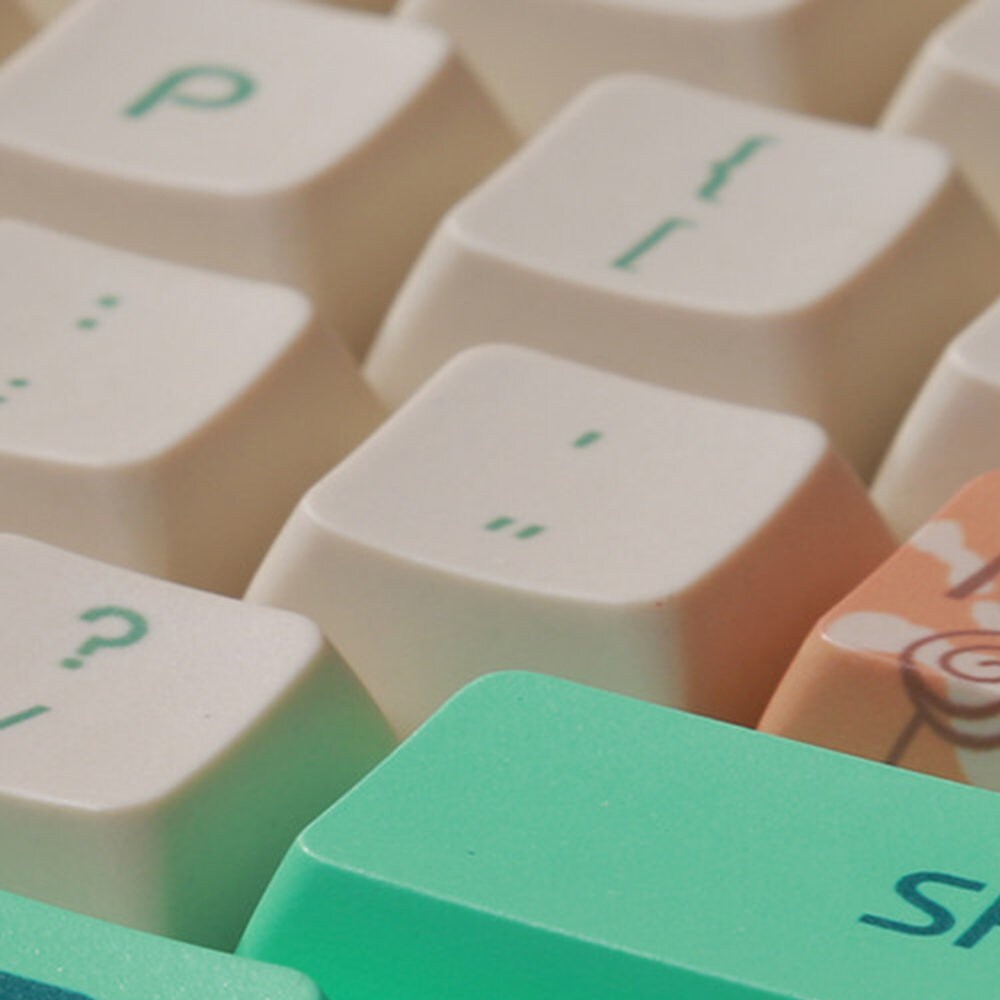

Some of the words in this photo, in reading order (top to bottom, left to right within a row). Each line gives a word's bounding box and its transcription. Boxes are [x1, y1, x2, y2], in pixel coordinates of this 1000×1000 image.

[122, 65, 257, 120] P
[695, 134, 779, 203] {
[58, 603, 149, 671] ?
